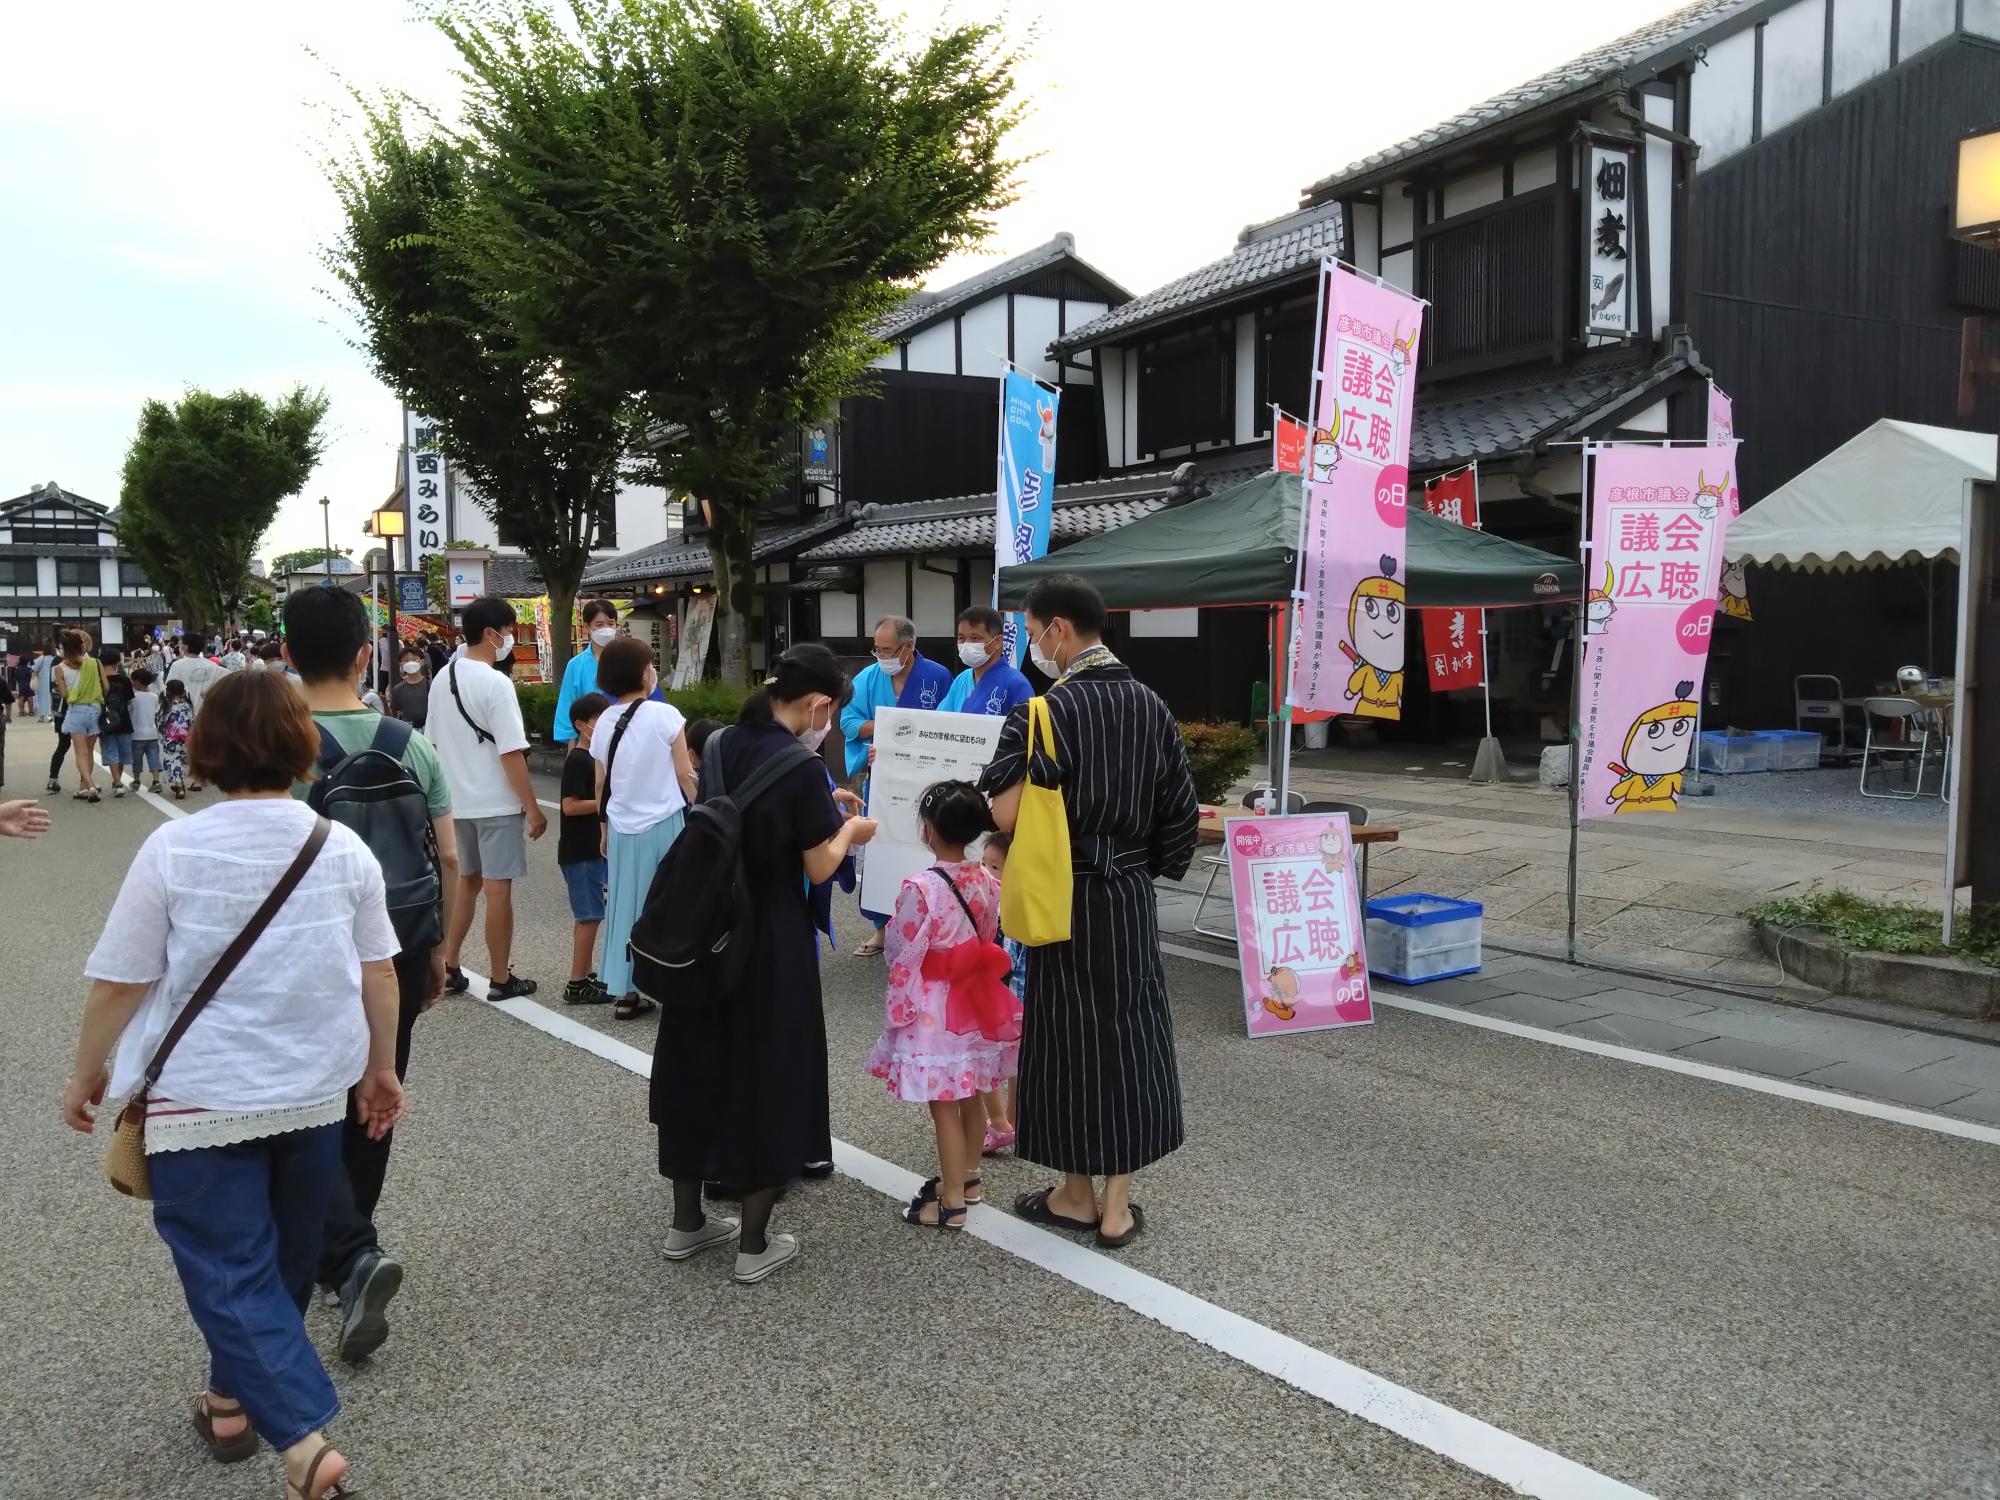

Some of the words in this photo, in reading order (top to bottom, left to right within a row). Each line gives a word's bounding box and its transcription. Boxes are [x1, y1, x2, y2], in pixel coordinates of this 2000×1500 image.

[1595, 157, 1627, 260] 佃煮
[1336, 313, 1391, 352] 彦根市議会
[1599, 312, 1624, 322] かねやす
[1342, 348, 1397, 409] 議会
[1340, 406, 1391, 463] 広聴
[1378, 482, 1406, 507] の日
[1609, 486, 1690, 503] 彦根市議会
[1620, 513, 1704, 553] 議会
[1614, 561, 1699, 600] 広聴
[1682, 615, 1711, 637] の日
[1235, 834, 1261, 846] 開催中
[1263, 842, 1317, 857] 彦根市議会
[1263, 868, 1335, 915] 議会
[1271, 916, 1344, 965] 広聴
[1337, 978, 1365, 1003] の日
